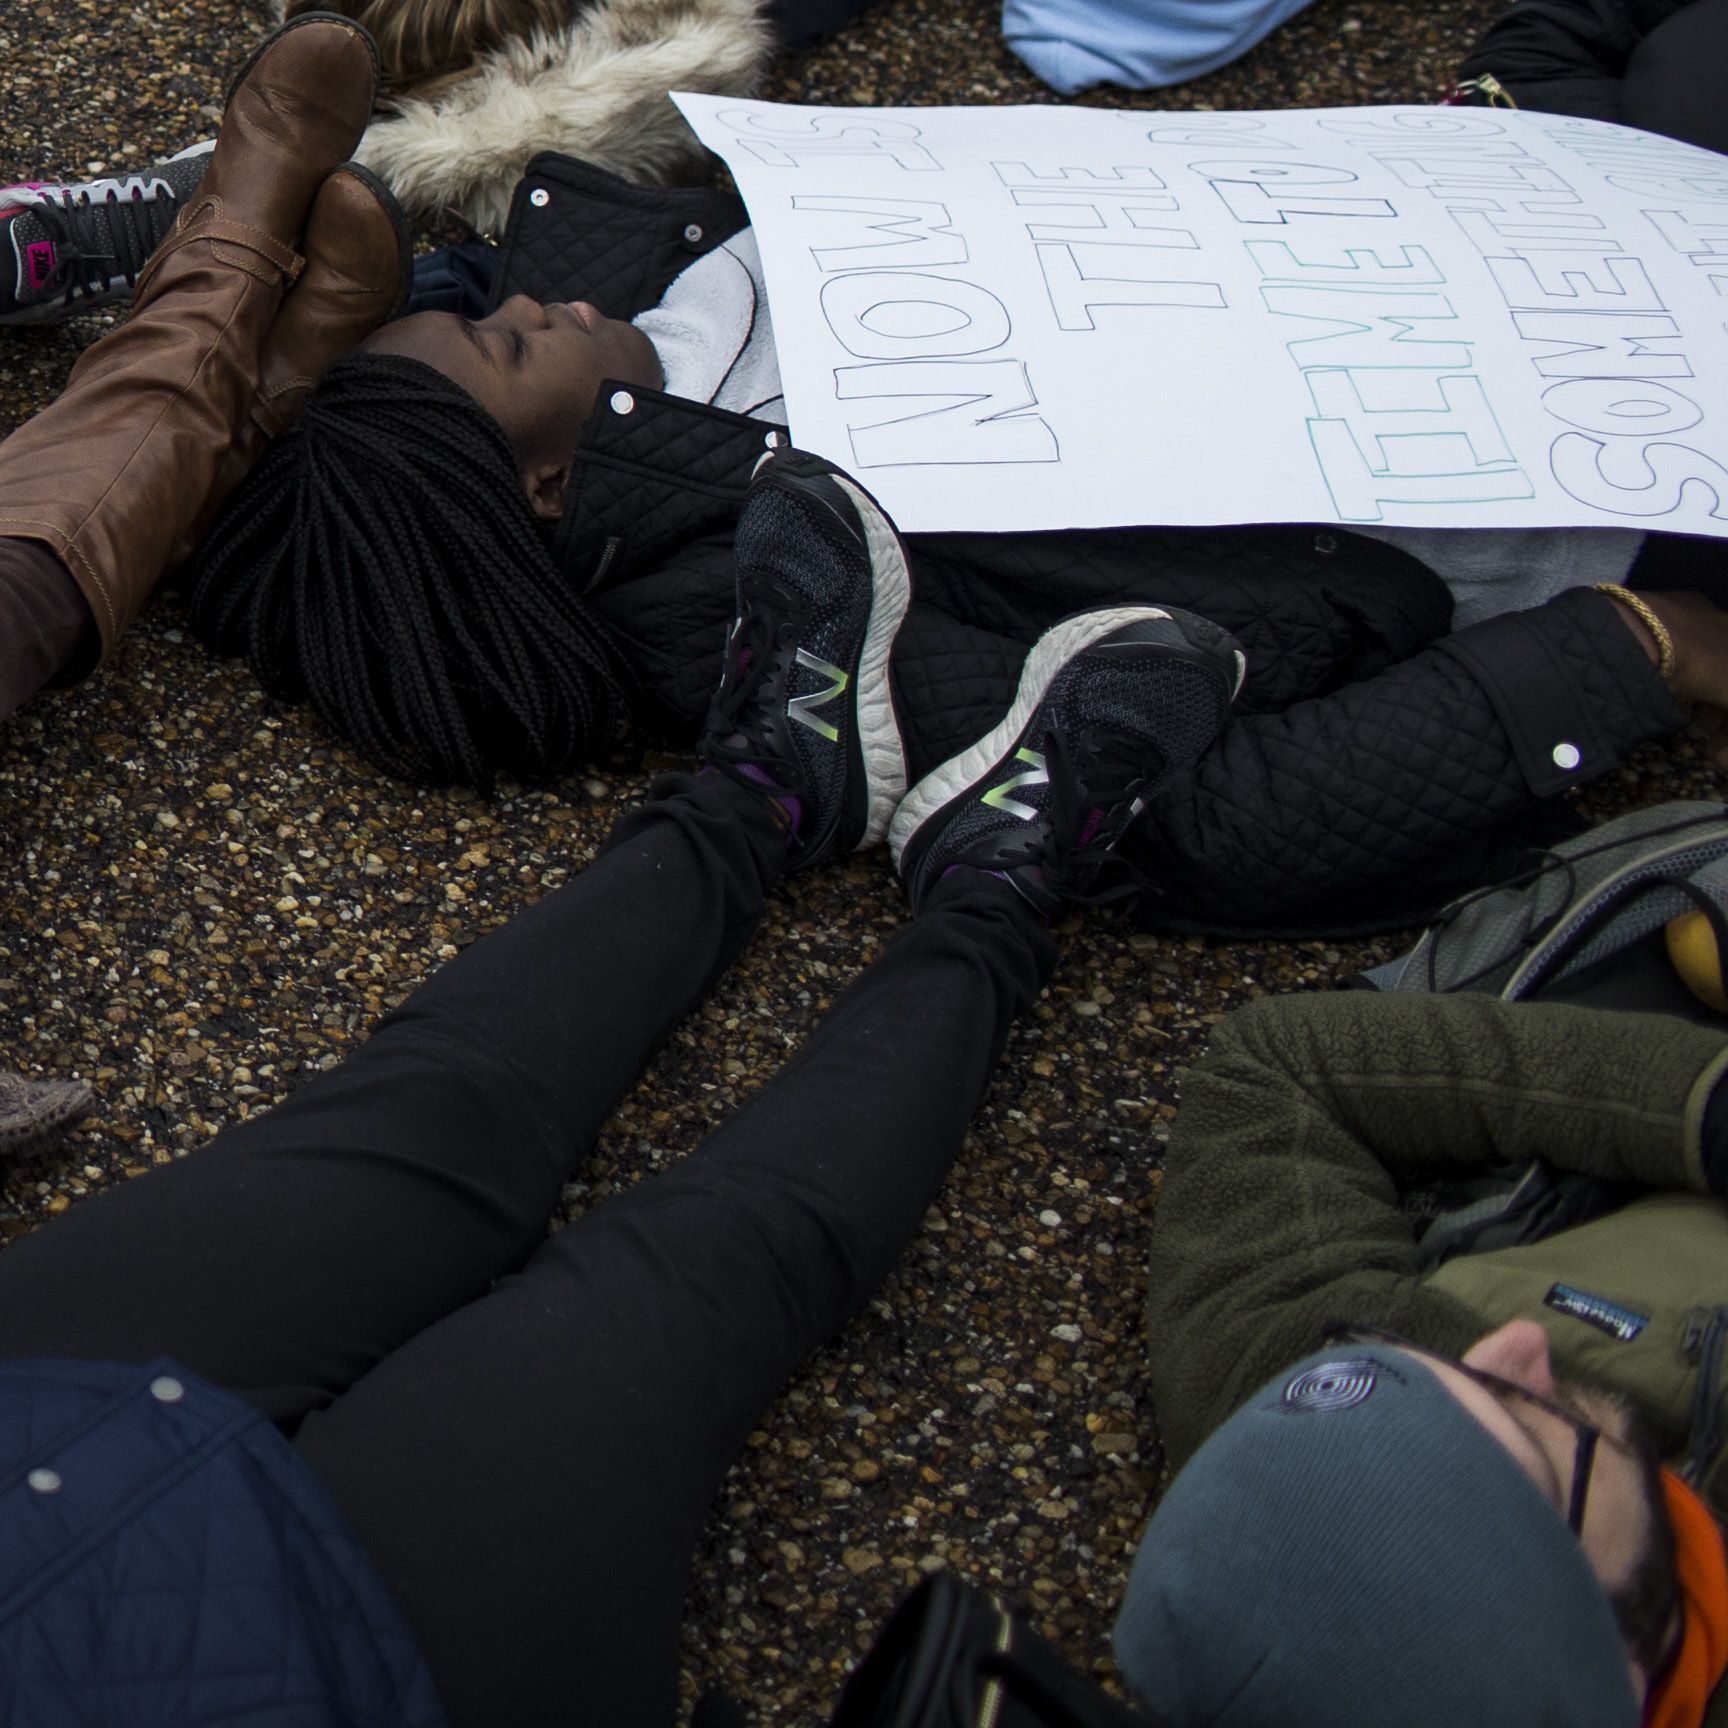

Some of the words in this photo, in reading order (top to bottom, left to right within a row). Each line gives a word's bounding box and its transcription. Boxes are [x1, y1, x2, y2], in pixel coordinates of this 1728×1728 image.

[990, 159, 1230, 332] THE
[1186, 157, 1400, 226] TO
[1316, 110, 1728, 521] SOMETHING
[789, 193, 1062, 469] NOW
[1241, 237, 1537, 522] TIME
